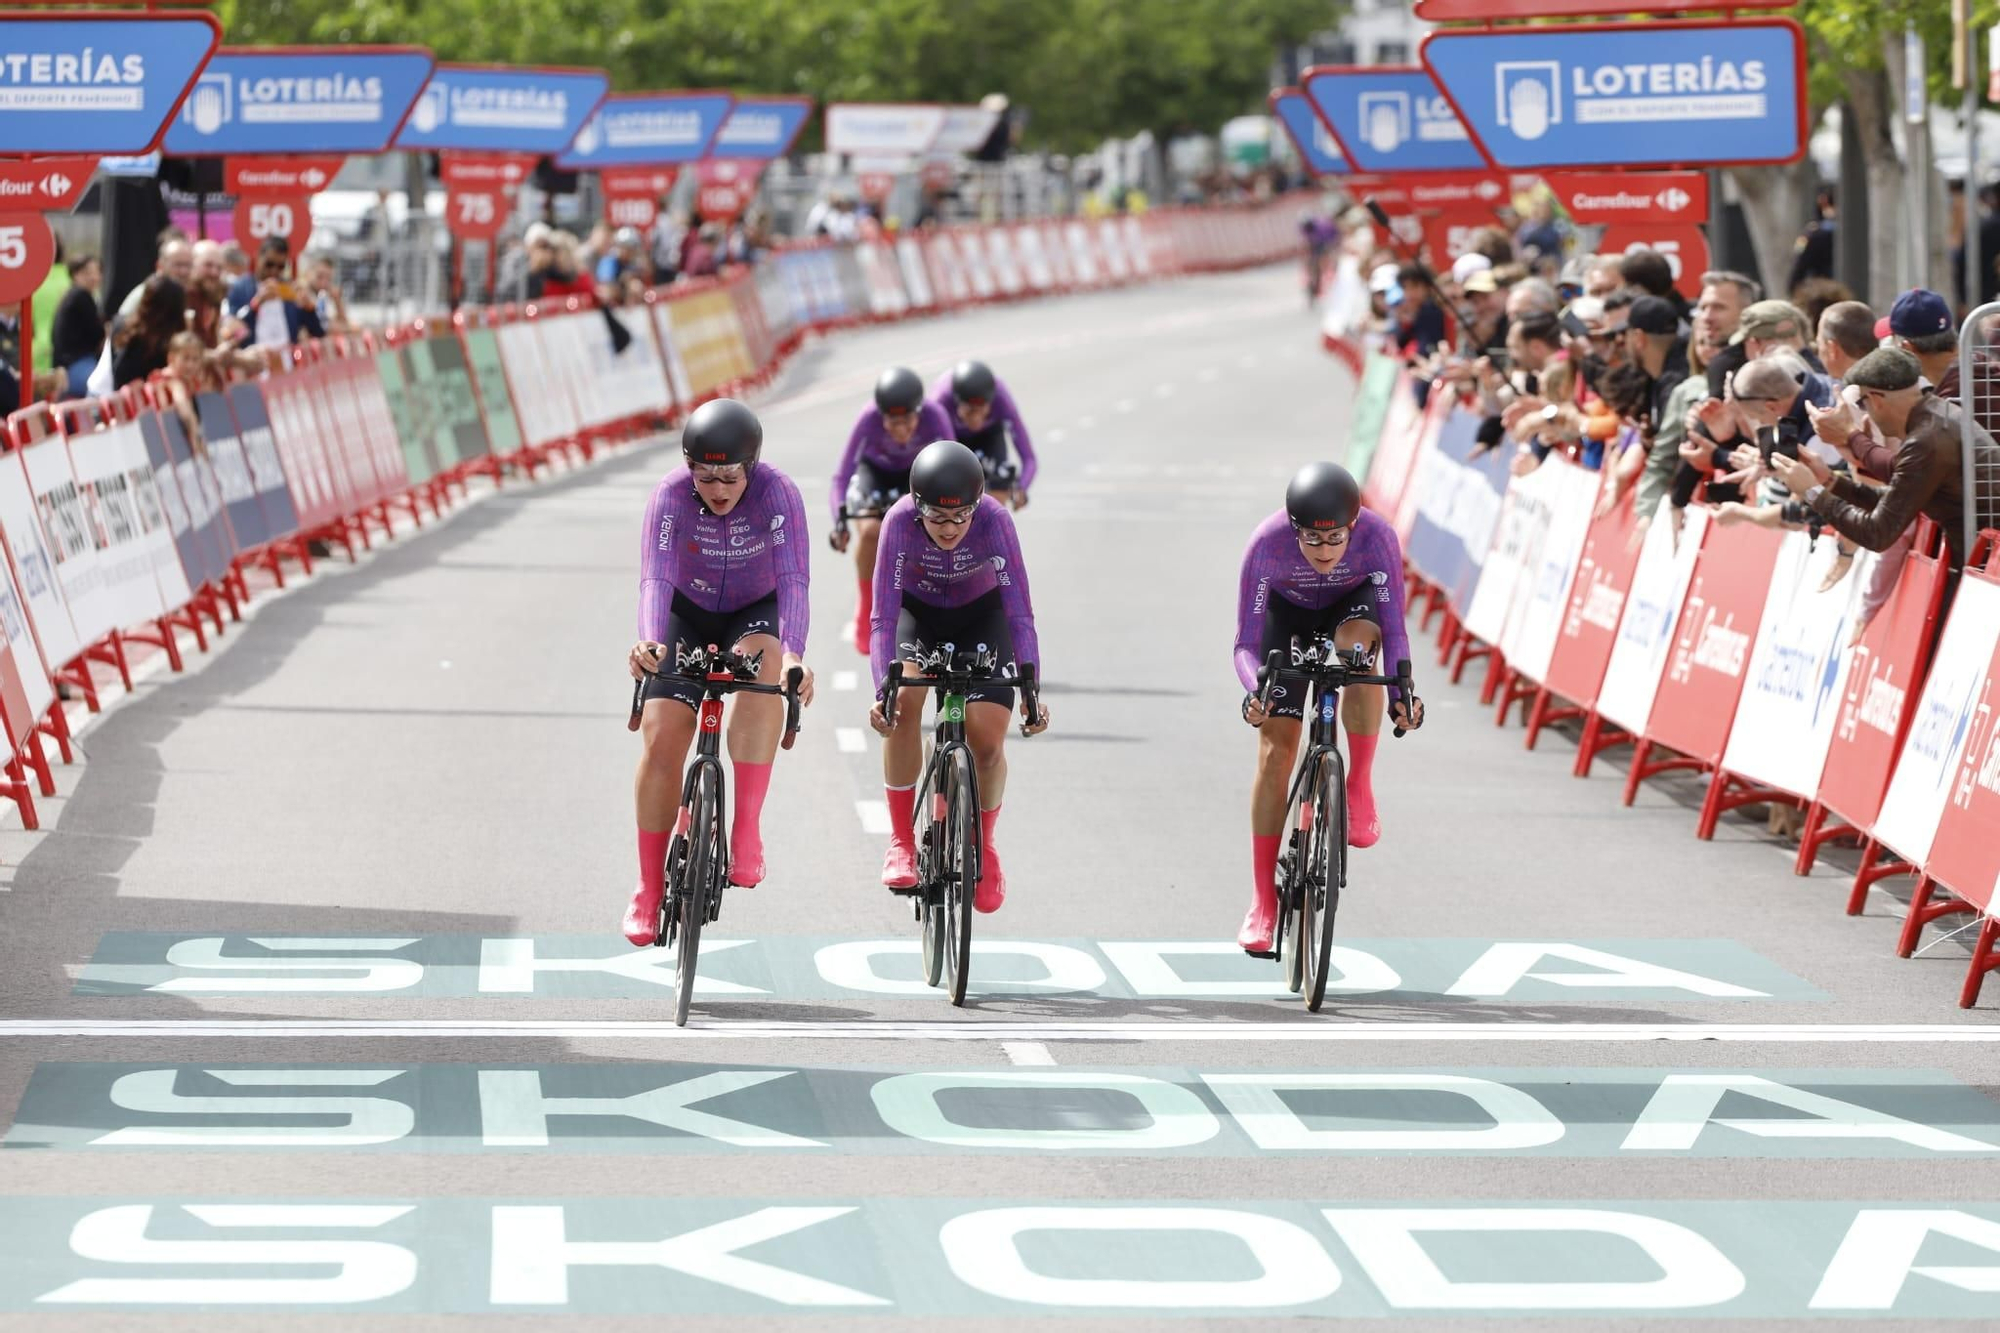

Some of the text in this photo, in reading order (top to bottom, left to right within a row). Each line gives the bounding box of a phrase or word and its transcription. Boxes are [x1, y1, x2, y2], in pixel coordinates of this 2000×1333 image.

[0, 47, 144, 84] TERÍAS
[1572, 55, 1767, 95] LOTERÍAS
[239, 72, 383, 102] LOTERÍAS
[456, 193, 495, 224] 75
[1572, 191, 1653, 210] Carrefour
[249, 203, 294, 238] 50
[659, 515, 675, 551] INDIBA
[729, 524, 751, 535] ISEO
[702, 542, 765, 556] BONGIOANNI
[894, 551, 906, 590] INDIBA
[1253, 576, 1270, 614] INDIBA
